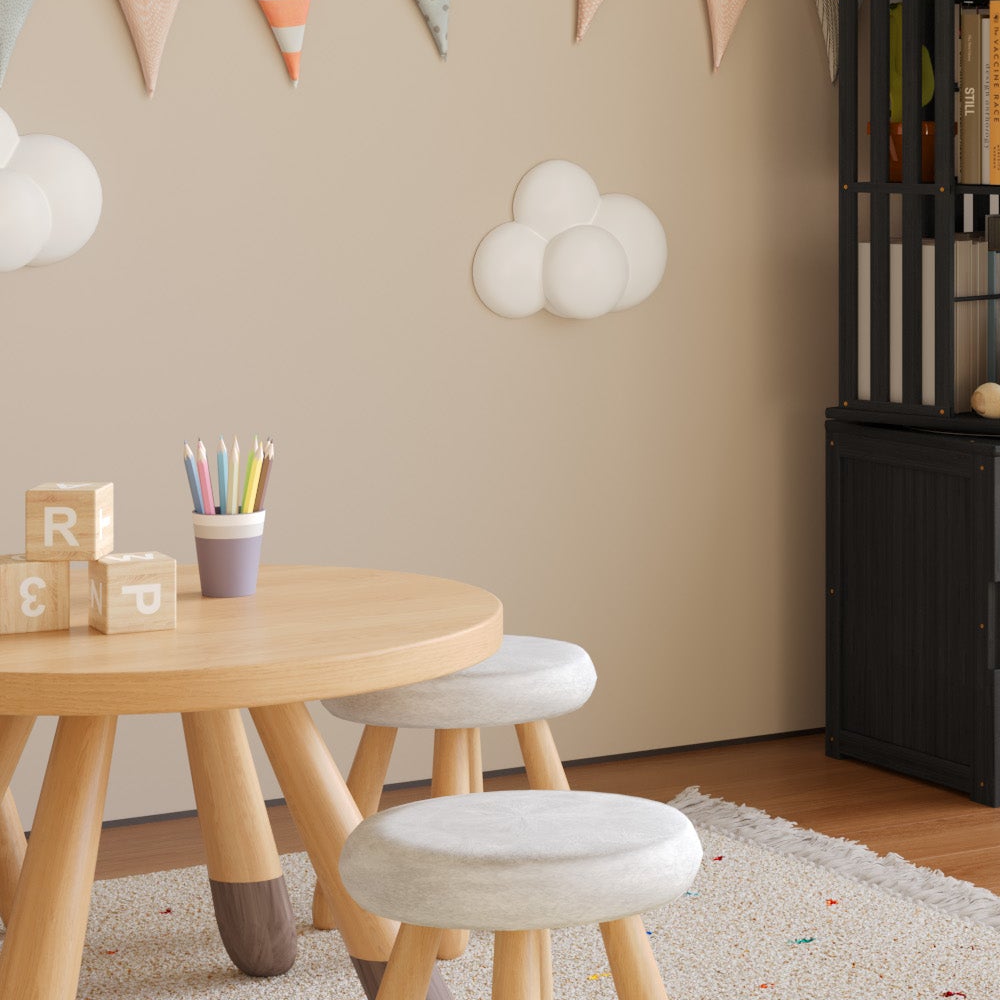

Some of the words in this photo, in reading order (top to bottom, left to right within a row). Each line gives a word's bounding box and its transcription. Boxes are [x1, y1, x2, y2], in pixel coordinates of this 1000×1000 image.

[964, 87, 974, 116] STILL
[44, 506, 80, 547] R
[122, 584, 161, 615] P
